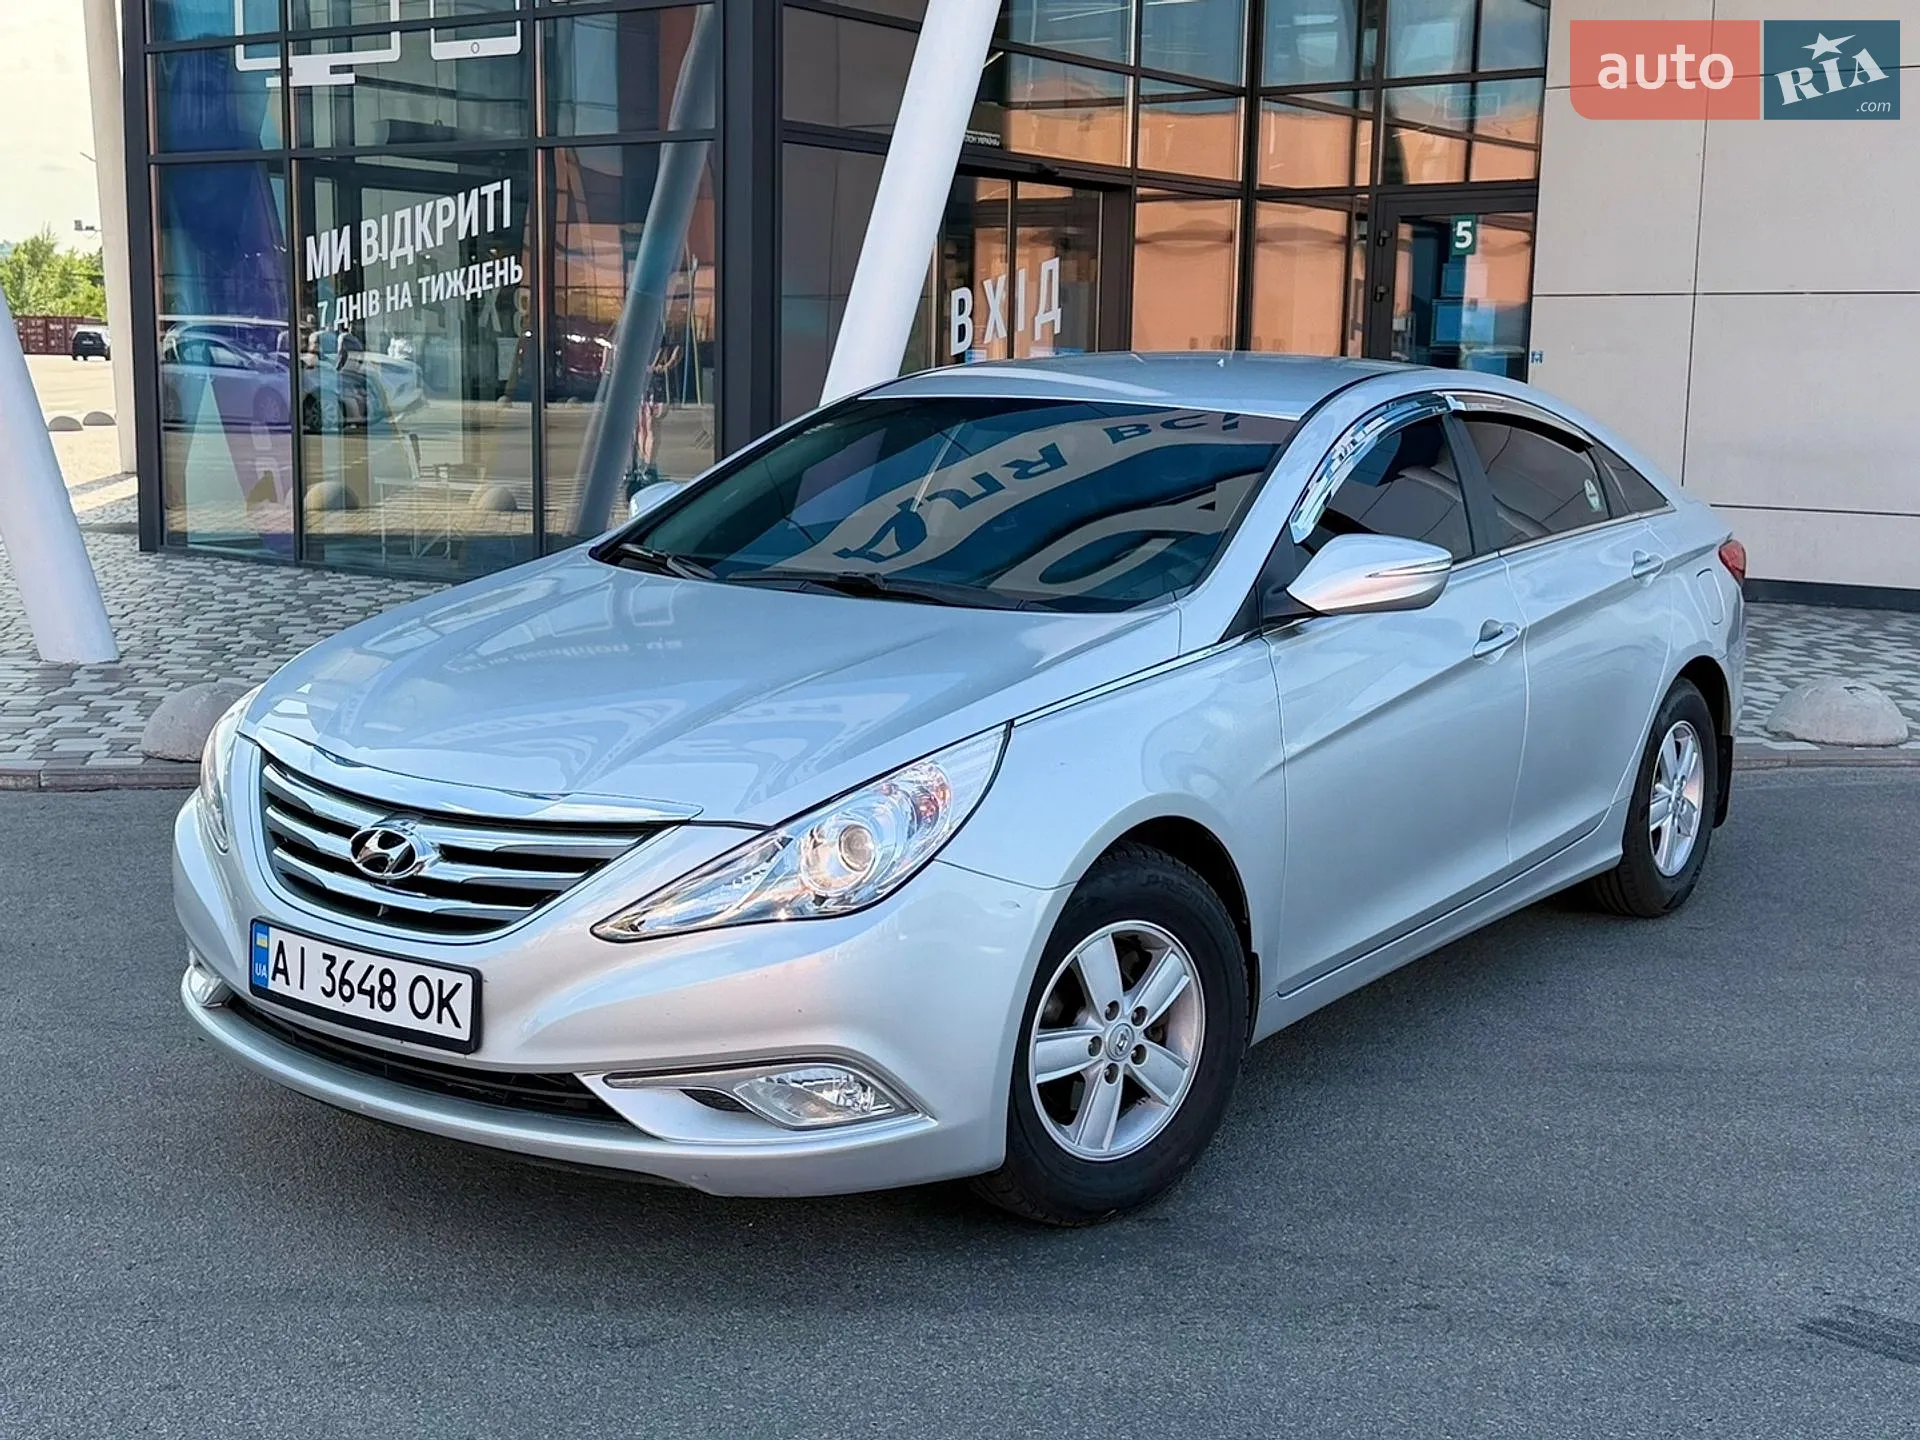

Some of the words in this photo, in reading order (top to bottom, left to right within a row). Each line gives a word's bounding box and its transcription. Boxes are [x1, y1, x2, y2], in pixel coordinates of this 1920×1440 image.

[306, 225, 351, 281] МИ
[360, 179, 511, 270] ВІДКРИТІ
[1454, 221, 1473, 249] 5
[317, 301, 329, 328] 7
[334, 289, 380, 331] ДНІВ
[386, 281, 413, 313] НА
[418, 255, 524, 305] ТИЖДЕНЬ
[951, 256, 1062, 356] ВХІД
[255, 962, 268, 980] UA
[321, 953, 396, 1012] 3648
[409, 975, 463, 1029] OK
